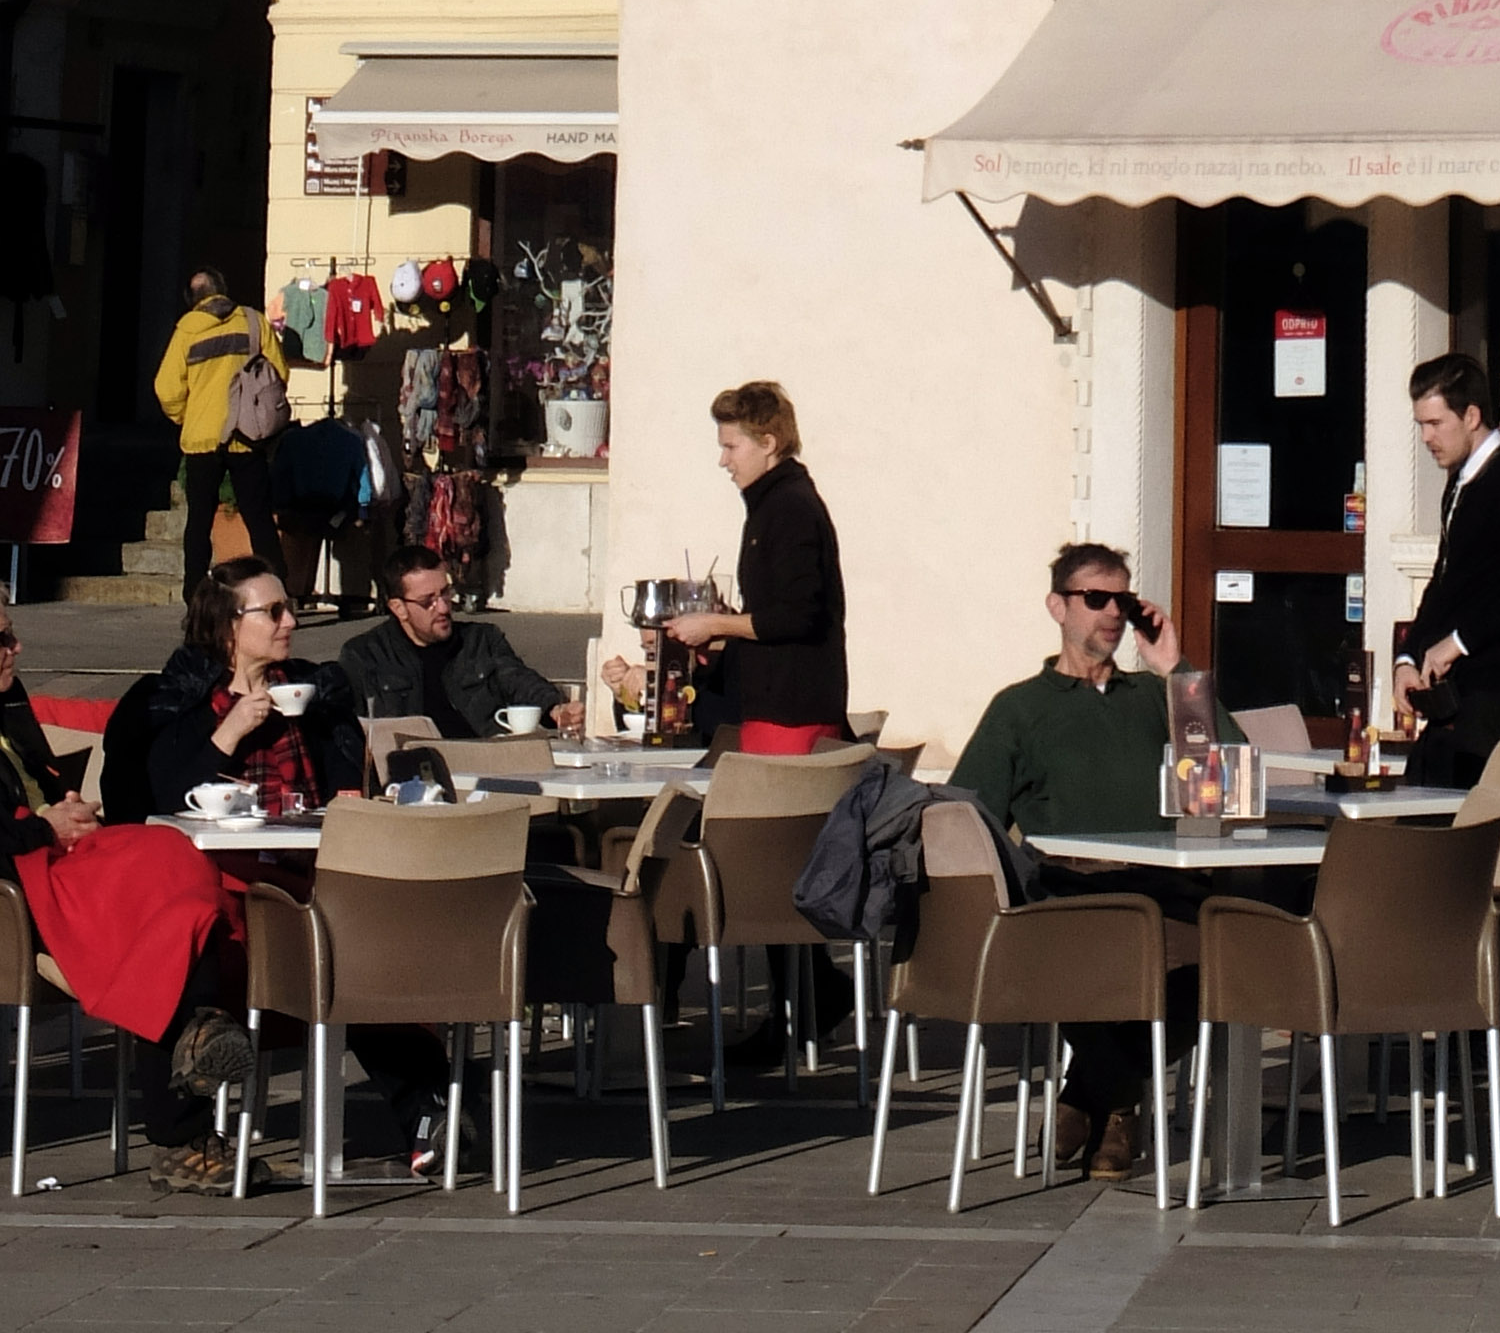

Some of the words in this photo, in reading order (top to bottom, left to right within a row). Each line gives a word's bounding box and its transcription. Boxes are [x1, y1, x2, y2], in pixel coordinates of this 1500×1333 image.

[546, 132, 588, 144] HAND
[974, 153, 1002, 173] Sol
[1004, 154, 1022, 179] je
[1025, 155, 1083, 179] morje,
[1089, 154, 1105, 175] ki
[1109, 156, 1127, 175] ni
[1133, 155, 1190, 181] moglo
[1248, 160, 1270, 176] na
[1347, 155, 1361, 176] Il
[1366, 154, 1401, 176] sale
[1421, 154, 1433, 174] il
[1437, 157, 1486, 174] mare
